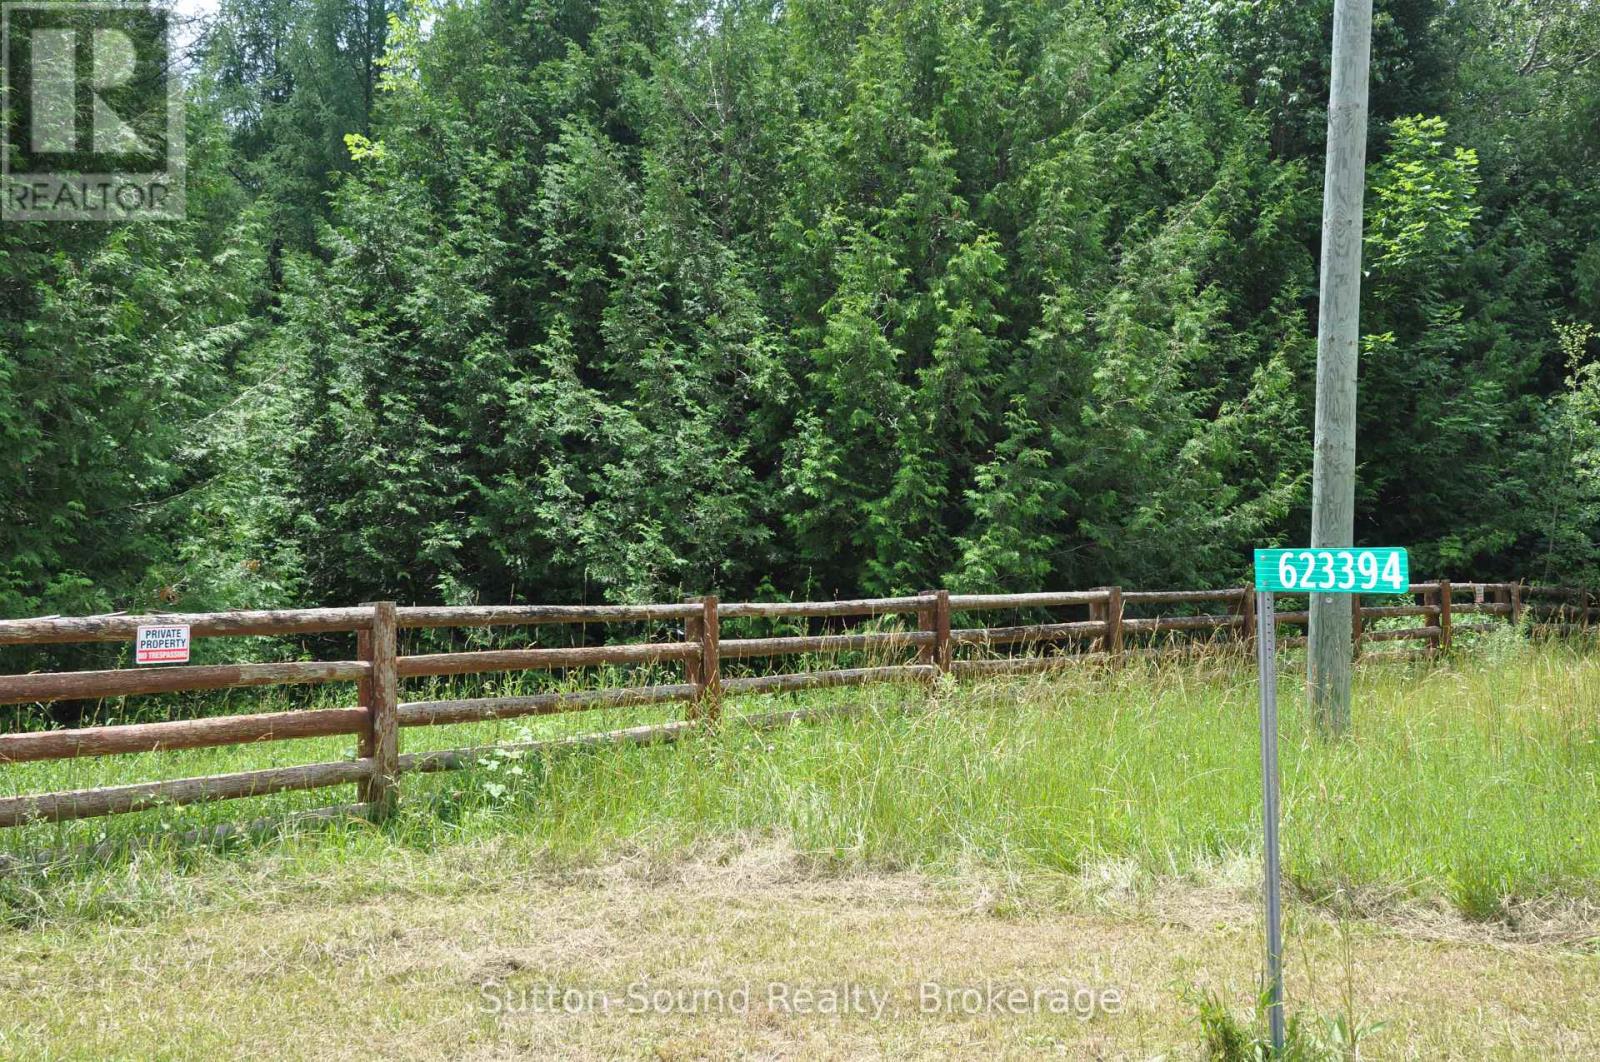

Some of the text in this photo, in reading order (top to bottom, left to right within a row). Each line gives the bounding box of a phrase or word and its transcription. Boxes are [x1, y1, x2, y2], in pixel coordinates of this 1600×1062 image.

[1279, 552, 1403, 589] 623394
[145, 629, 182, 639] PRIVATE
[140, 638, 186, 649] PROPERTY
